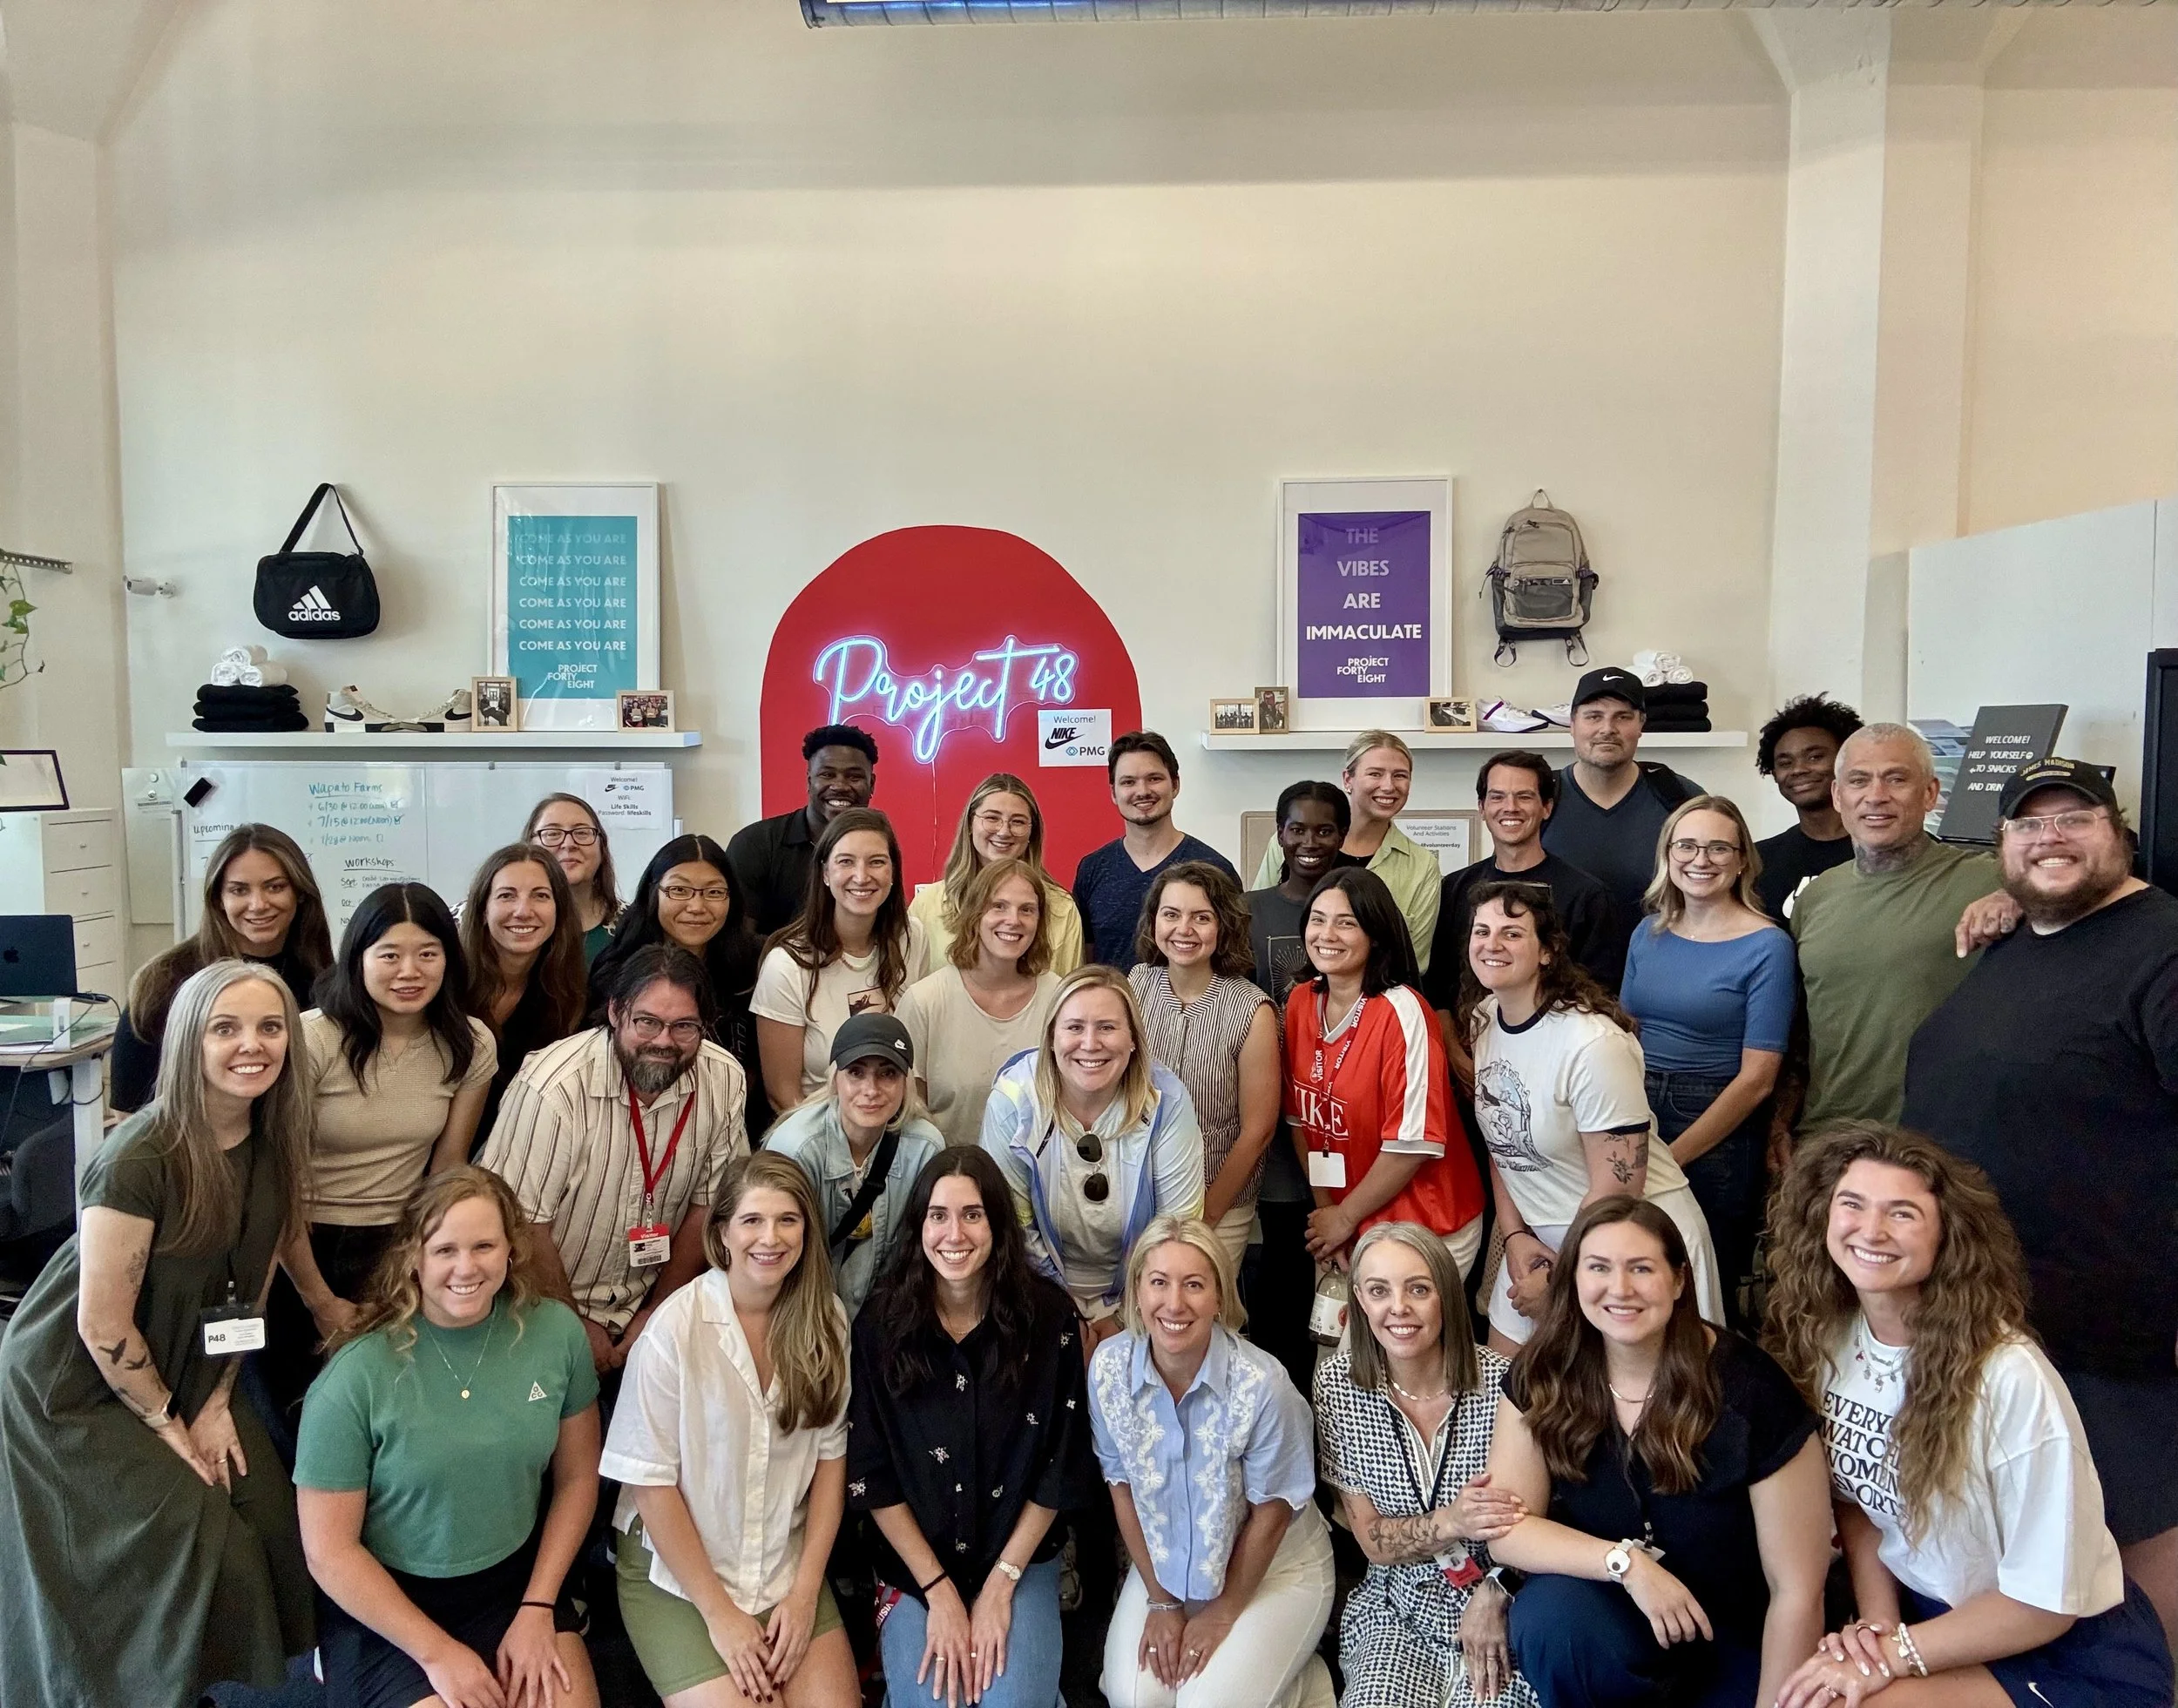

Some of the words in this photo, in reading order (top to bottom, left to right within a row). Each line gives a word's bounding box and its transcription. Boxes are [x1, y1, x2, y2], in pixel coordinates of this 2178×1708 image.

[557, 534, 572, 543] AS
[575, 534, 600, 543] YOU
[604, 534, 626, 543] ARE
[1345, 528, 1379, 543] THE
[519, 556, 553, 565] COME
[557, 556, 572, 565] AS
[575, 556, 600, 565] YOU
[604, 556, 626, 565] ARE
[1336, 560, 1390, 577] VIBES
[519, 577, 553, 586] COME
[557, 577, 572, 586] AS
[575, 577, 600, 586] YOU
[604, 577, 626, 586] ARE
[519, 597, 553, 608] COME
[557, 597, 572, 608] AS
[575, 597, 600, 608] YOU
[604, 597, 626, 608] ARE
[1343, 593, 1381, 609] ARE
[287, 608, 341, 621] adidas
[519, 619, 553, 629] COME
[557, 619, 572, 629] AS
[575, 619, 600, 629] YOU
[604, 619, 626, 629] ARE
[1306, 624, 1422, 640] IMMACULATE
[519, 641, 553, 651] COME
[557, 641, 572, 651] AS
[575, 641, 600, 651] YOU
[604, 641, 626, 651] ARE
[1336, 666, 1368, 675] FORTY
[547, 672, 577, 681] FORTY
[1357, 674, 1386, 683] EIGHT
[815, 638, 1060, 760] Project
[1032, 654, 1076, 702] 48
[1053, 715, 1096, 724] Welcome!
[1051, 727, 1077, 739] NIKE
[1985, 735, 2031, 744] WELCOME!
[1079, 746, 1106, 755] PMG
[1968, 751, 1985, 759] HELP
[1990, 751, 2026, 759] YOURSELF
[1975, 764, 1985, 773] TO
[1986, 764, 2018, 773] SNACKS
[2020, 761, 2042, 777] JAMES
[308, 782, 350, 796] Wapato
[354, 782, 383, 793] Farms
[1349, 997, 1368, 1029] VISITOR
[1335, 1040, 1351, 1070] VISITOR
[208, 1333, 227, 1344] P48
